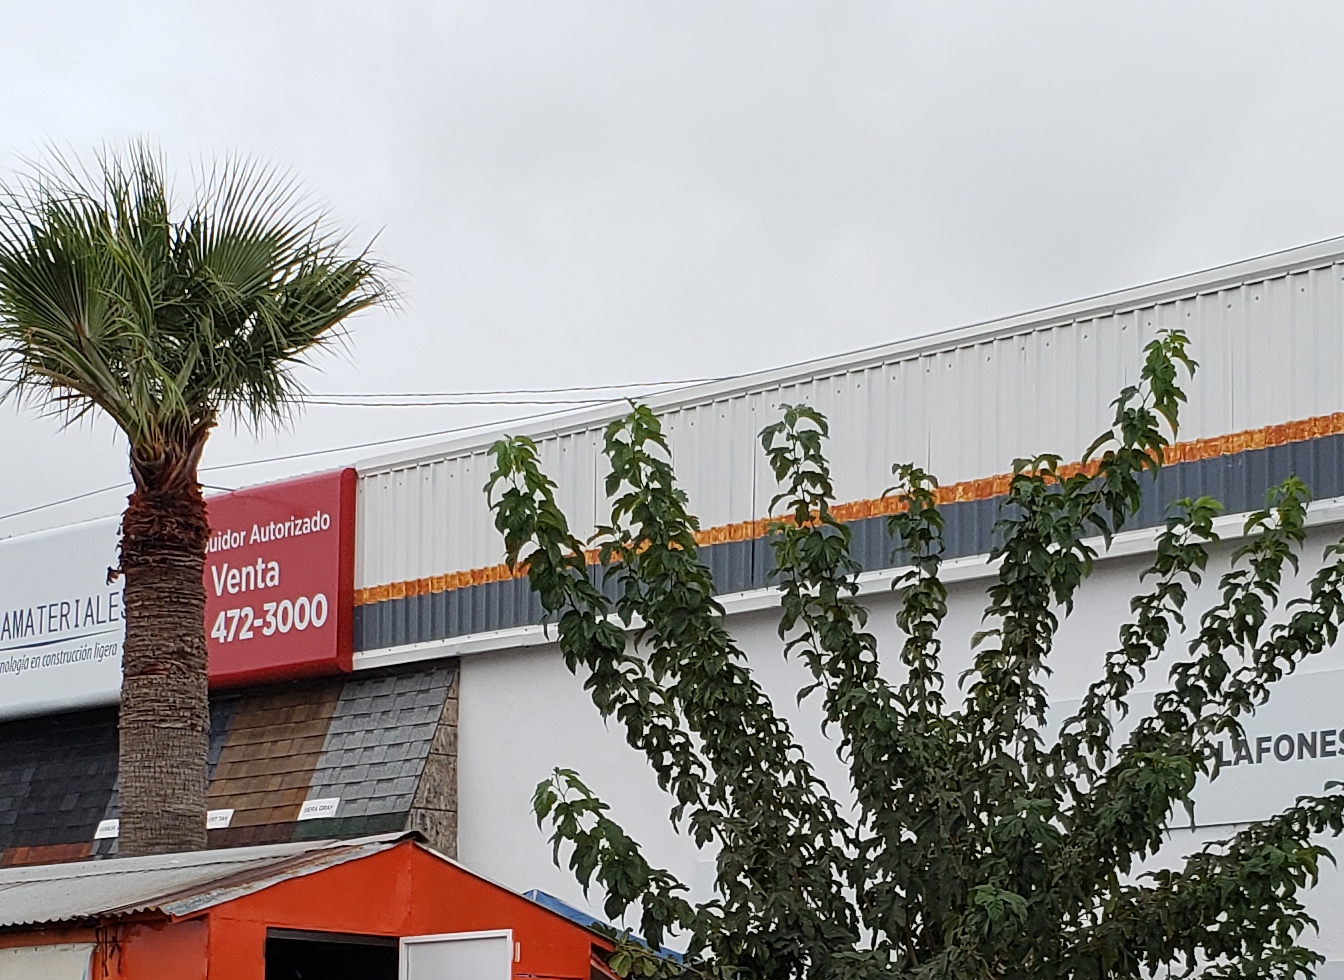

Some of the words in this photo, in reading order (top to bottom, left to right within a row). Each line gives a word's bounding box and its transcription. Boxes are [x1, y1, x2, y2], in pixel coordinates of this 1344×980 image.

[249, 510, 331, 545] Autorizado
[211, 557, 280, 597] Venta
[211, 593, 328, 644] 472-3000
[30, 656, 41, 669] en
[94, 642, 118, 663] ligera
